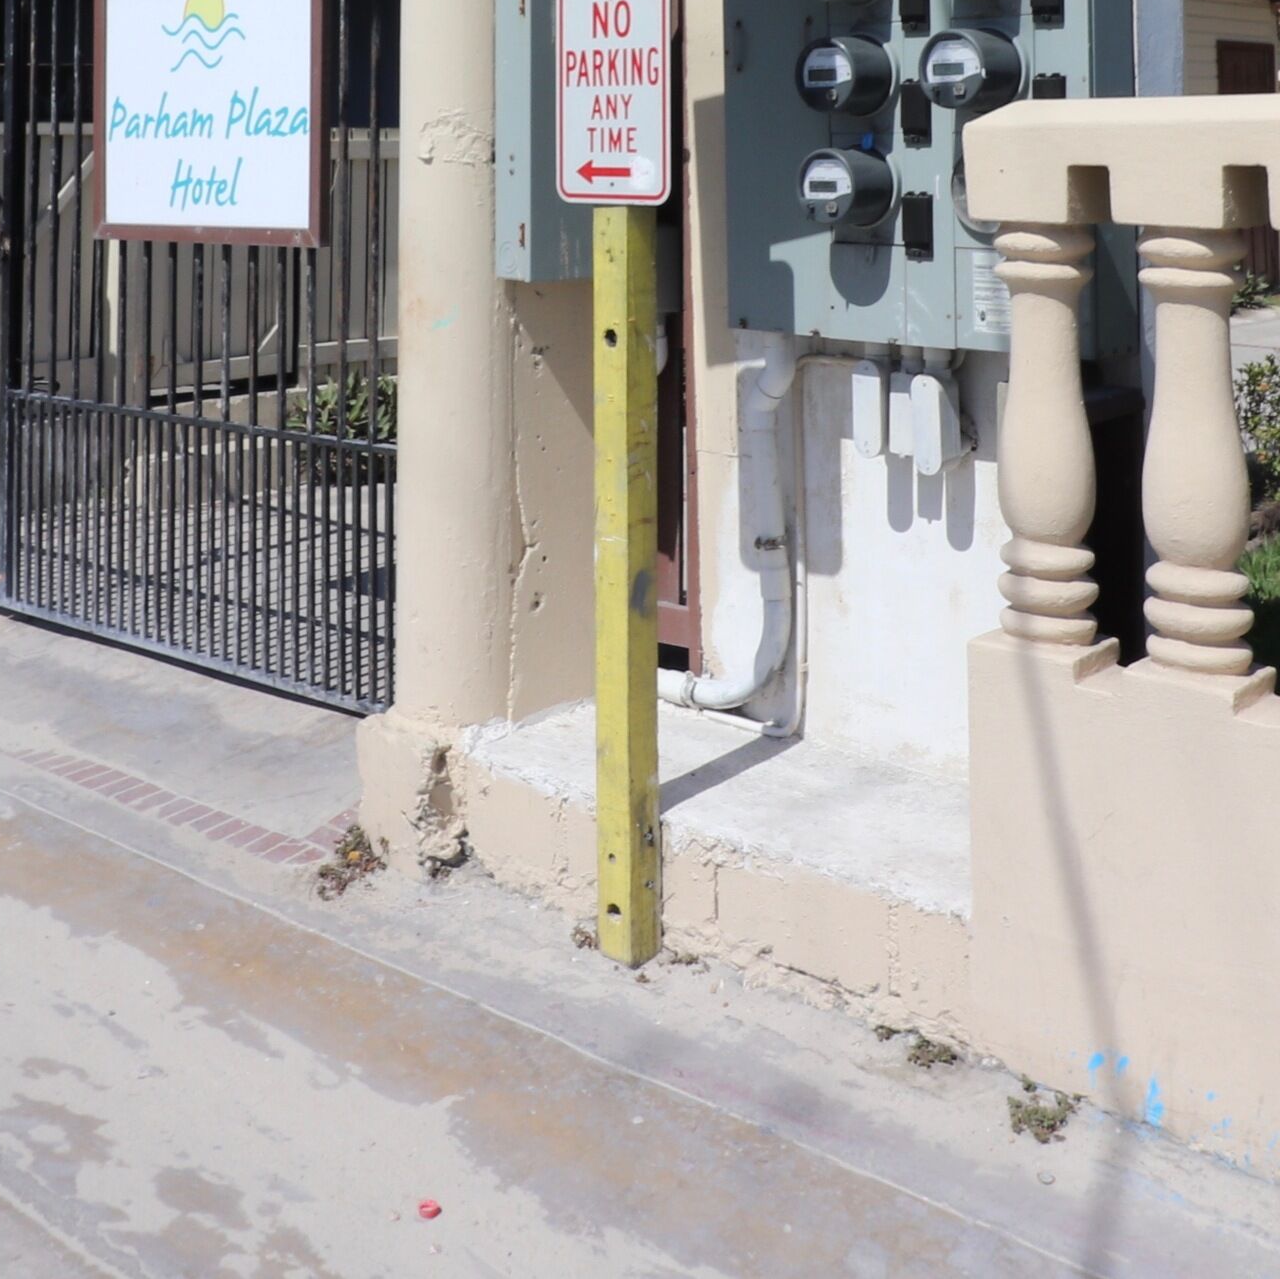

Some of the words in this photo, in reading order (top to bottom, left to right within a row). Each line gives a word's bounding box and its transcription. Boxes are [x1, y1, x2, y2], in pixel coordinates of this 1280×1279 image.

[592, 0, 631, 39] NO
[565, 47, 660, 88] PARKING
[109, 91, 213, 142] Parham
[225, 86, 310, 140] Plaza
[591, 94, 633, 120] ANY
[586, 127, 638, 153] TIME
[169, 157, 243, 211] Hotel
